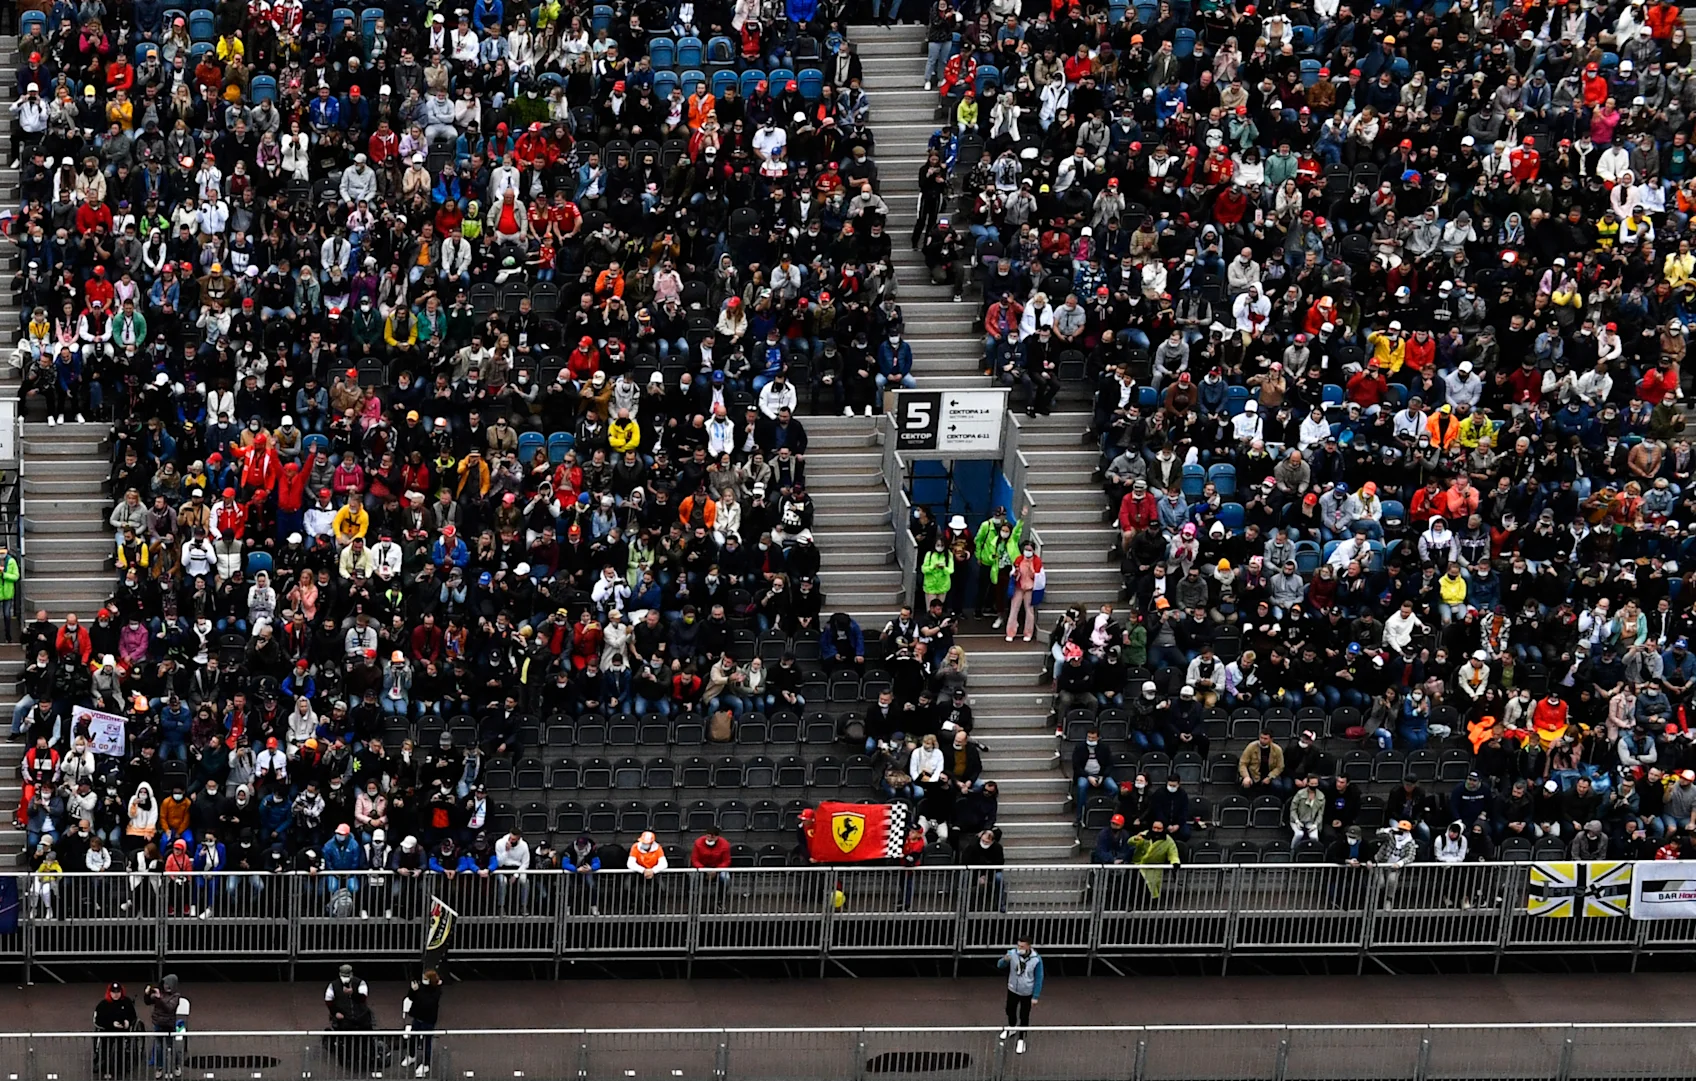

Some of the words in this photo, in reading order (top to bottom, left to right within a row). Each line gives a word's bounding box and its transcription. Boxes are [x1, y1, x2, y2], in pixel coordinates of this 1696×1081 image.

[906, 402, 932, 429] 5
[900, 432, 933, 440] СЕКТОР
[1534, 879, 1618, 902] Jensn
[1658, 892, 1677, 901] BAR
